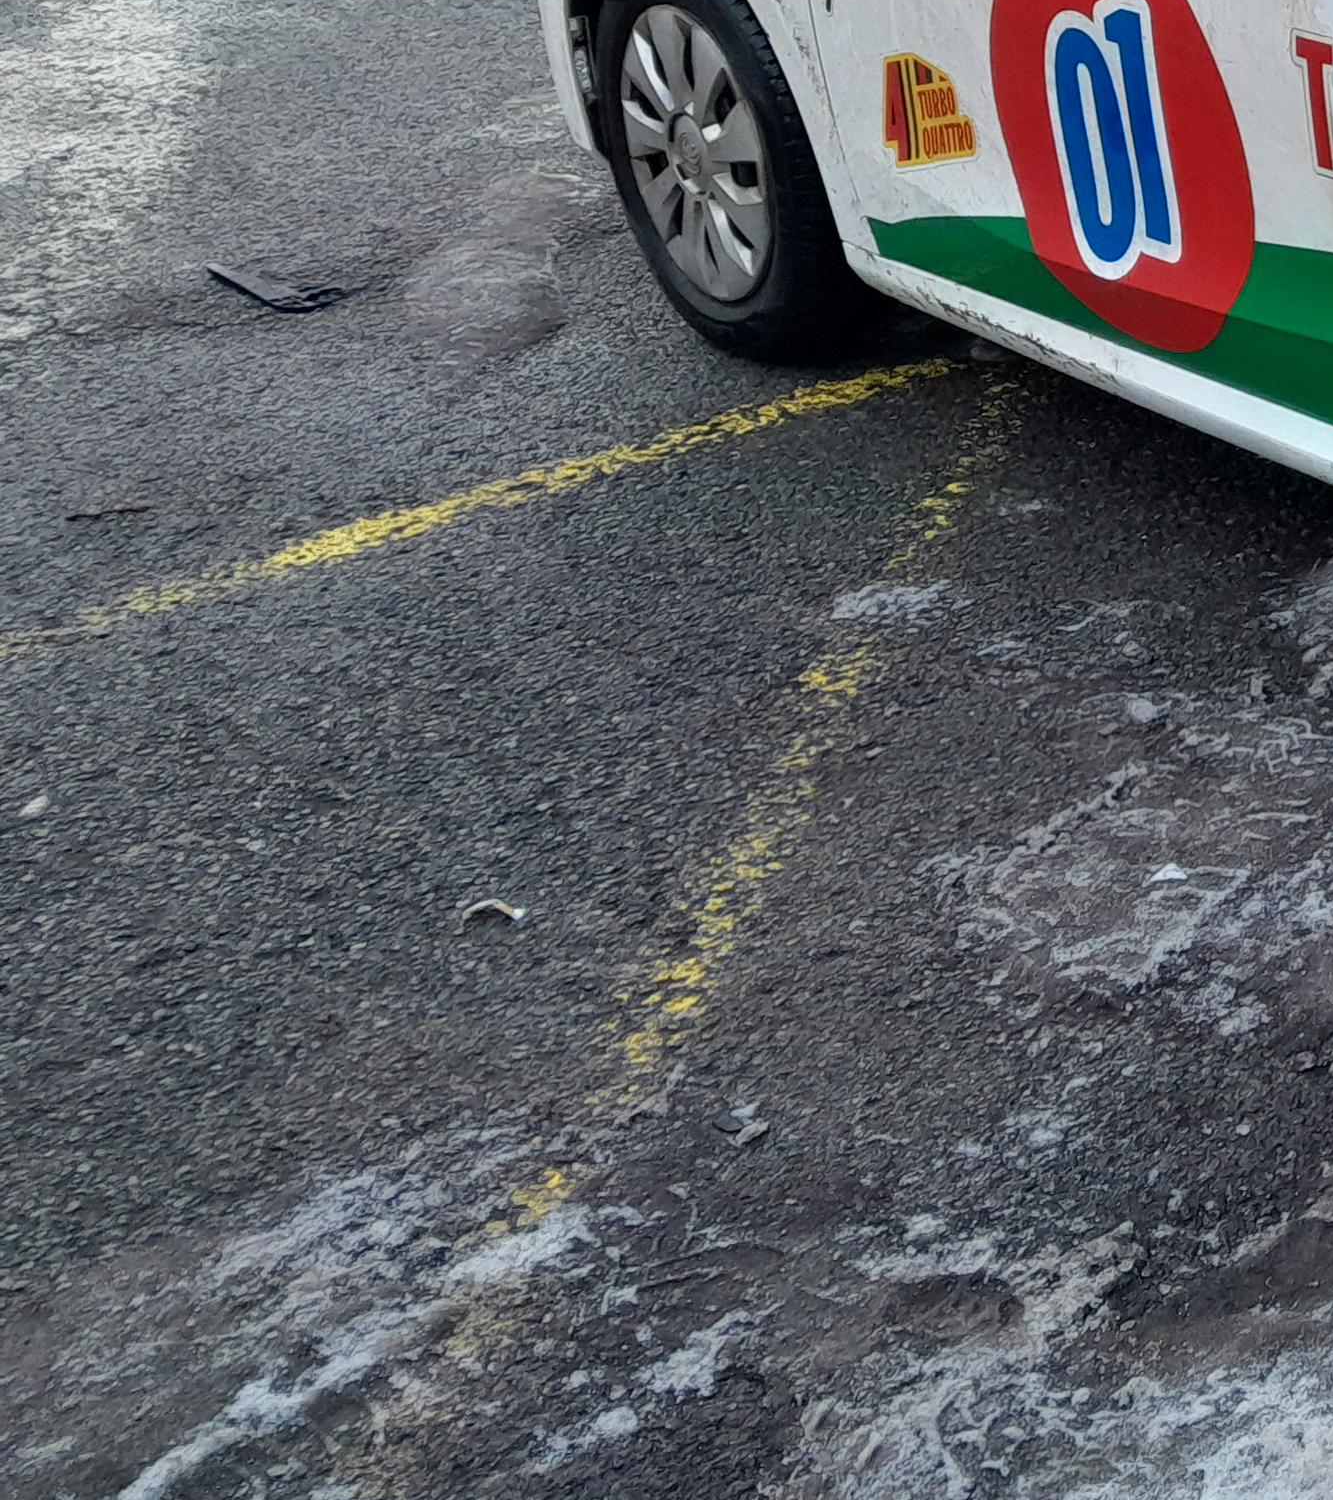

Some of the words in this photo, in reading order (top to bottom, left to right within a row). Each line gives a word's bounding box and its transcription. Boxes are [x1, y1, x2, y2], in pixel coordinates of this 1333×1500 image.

[917, 86, 956, 121] TURBO
[922, 120, 973, 159] QUATTRO
[1053, 6, 1173, 264] 01
